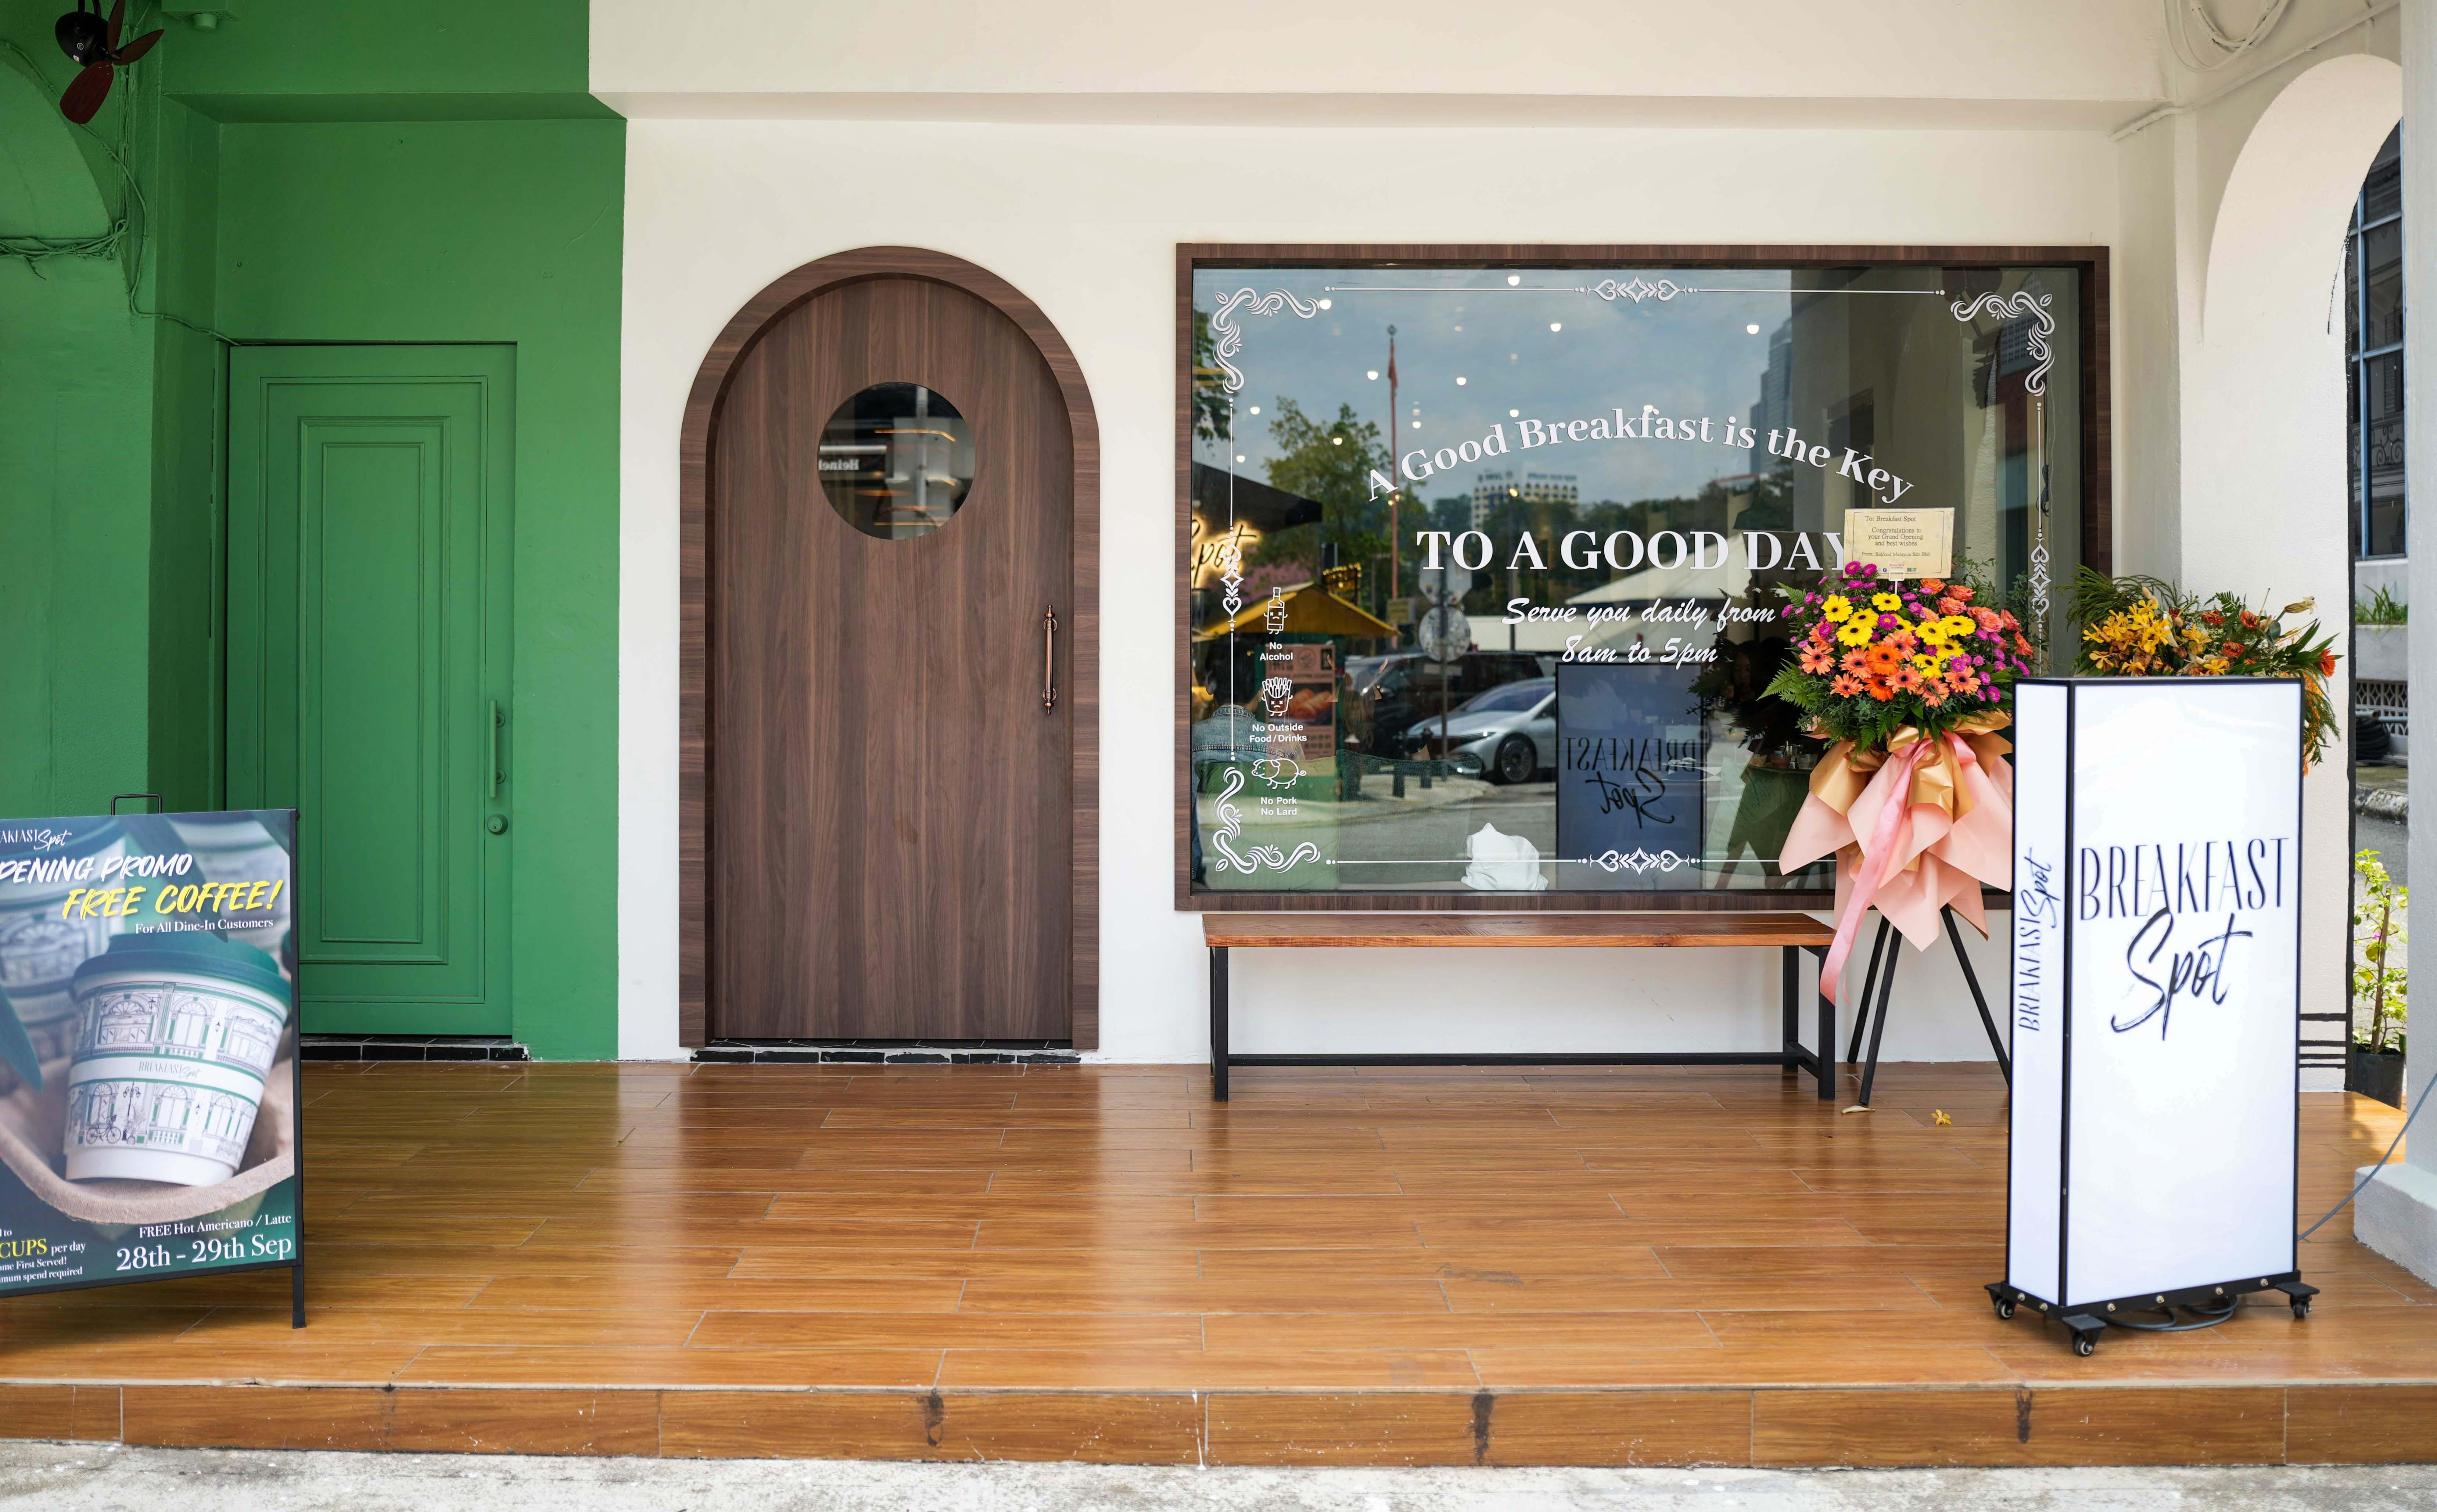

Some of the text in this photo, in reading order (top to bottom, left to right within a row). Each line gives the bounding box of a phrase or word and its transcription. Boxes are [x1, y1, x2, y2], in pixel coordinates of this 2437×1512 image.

[1369, 406, 1914, 504] A Good Breakfast is the Key
[1417, 531, 1493, 570] TO
[1506, 531, 1547, 569] A
[1561, 531, 1729, 570] GOOD
[1501, 597, 1776, 632] Serve you daily from
[1259, 652, 1293, 661] Alcohol
[1269, 642, 1282, 650] No
[1562, 635, 1718, 670] 8am to 5pm
[1249, 735, 1272, 743] Food
[1278, 734, 1307, 742] Drinks
[1252, 723, 1304, 732] No Outside
[1260, 796, 1298, 805] No Pork
[1261, 807, 1298, 816] No Lard
[33, 828, 72, 852] Spot
[100, 853, 193, 882] PROMO
[2080, 838, 2290, 921] BREAKFAST
[61, 879, 284, 920] FREE COFFEE!
[135, 919, 274, 934] For All Dine-In Customers
[2018, 847, 2061, 1032] BREAKFAST Spot
[2110, 905, 2253, 1042] Spot
[3, 1229, 12, 1237] to
[139, 1214, 292, 1238] FREE Hot Americano / Latte
[0, 1238, 86, 1258] CUPS per day
[116, 1243, 171, 1271] 28th
[191, 1236, 246, 1264] 29th
[251, 1233, 292, 1261] Sep
[16, 1260, 35, 1270] First
[37, 1256, 67, 1267] Served!
[23, 1270, 47, 1283] spend
[49, 1266, 83, 1279] required
